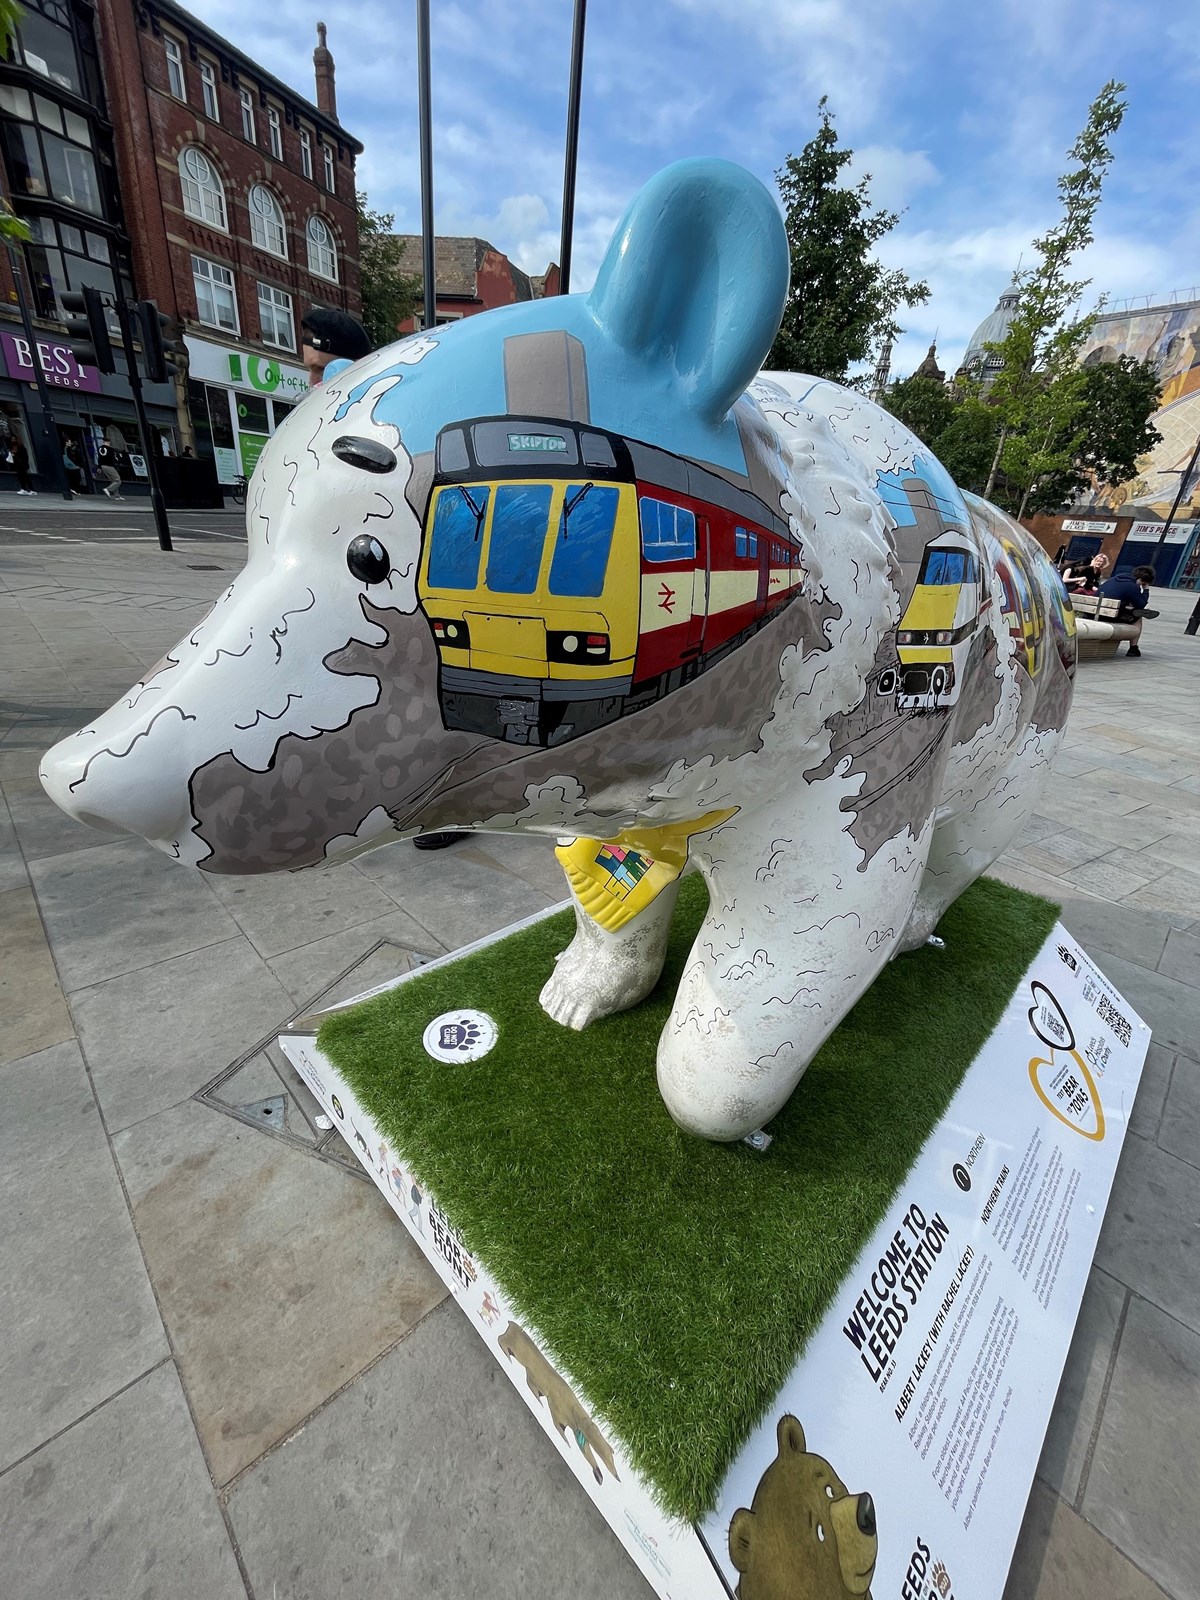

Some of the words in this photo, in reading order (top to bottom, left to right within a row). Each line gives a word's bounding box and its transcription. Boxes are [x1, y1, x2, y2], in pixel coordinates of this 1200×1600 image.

[45, 374, 80, 388] EEDS
[288, 378, 297, 390] of
[450, 1034, 458, 1045] NOT
[1086, 1037, 1096, 1052] Leeds
[1056, 1088, 1064, 1099] TEXT
[1062, 1075, 1079, 1101] BEAR
[1069, 1083, 1088, 1115] 70145
[965, 1133, 985, 1169] NORTHERN
[981, 1185, 1000, 1224] NORTHERN
[996, 1164, 1009, 1188] TRAINS
[429, 1212, 462, 1264] BEAR
[434, 1231, 472, 1288] HUNT
[977, 1266, 982, 1274] of
[979, 1254, 987, 1269] Leeds
[843, 1231, 911, 1349] WELCOME
[902, 1203, 926, 1239] TO
[968, 1272, 979, 1296] evolution
[861, 1294, 908, 1381] LEEDS
[901, 1213, 949, 1304] STATION
[957, 1303, 967, 1323] depicts
[998, 1318, 1003, 1326] to
[1000, 1306, 1008, 1319] mark
[895, 1377, 916, 1422] ALBERT
[912, 1339, 932, 1381] LACKEY
[928, 1310, 945, 1344] (WITH
[941, 1279, 960, 1315] RACHEL
[955, 1245, 974, 1282] LACKEY)
[948, 1327, 957, 1344] aged
[990, 1324, 1000, 1348] together
[913, 1424, 928, 1450] Railway
[924, 1396, 938, 1424] Station's
[936, 1361, 952, 1397] architecture
[954, 1319, 969, 1351] locomotives
[966, 1306, 974, 1320] from
[976, 1288, 982, 1296] to
[929, 1373, 938, 1389] train
[879, 1377, 888, 1393] BEAR
[920, 1387, 933, 1412] lifelong
[931, 1459, 942, 1480] From
[940, 1437, 951, 1461] oldest
[947, 1430, 953, 1440] to
[960, 1394, 966, 1406] A4
[963, 1376, 974, 1397] Pacific
[975, 1349, 984, 1366] same
[981, 1330, 990, 1350] model
[987, 1325, 993, 1333] as
[960, 1400, 974, 1429] Britannia
[920, 1433, 933, 1460] decade
[944, 1485, 952, 1500] the
[950, 1469, 958, 1487] end
[955, 1460, 960, 1472] of
[973, 1401, 982, 1419] Class
[951, 1474, 965, 1512] youngest
[962, 1460, 970, 1476] four
[967, 1422, 984, 1461] locomotives
[988, 1385, 996, 1401] from
[938, 1455, 954, 1490] Merchant
[963, 1505, 974, 1531] Albert
[971, 1476, 983, 1508] painted
[983, 1449, 992, 1467] Bear
[901, 1536, 930, 1600] EEDS
